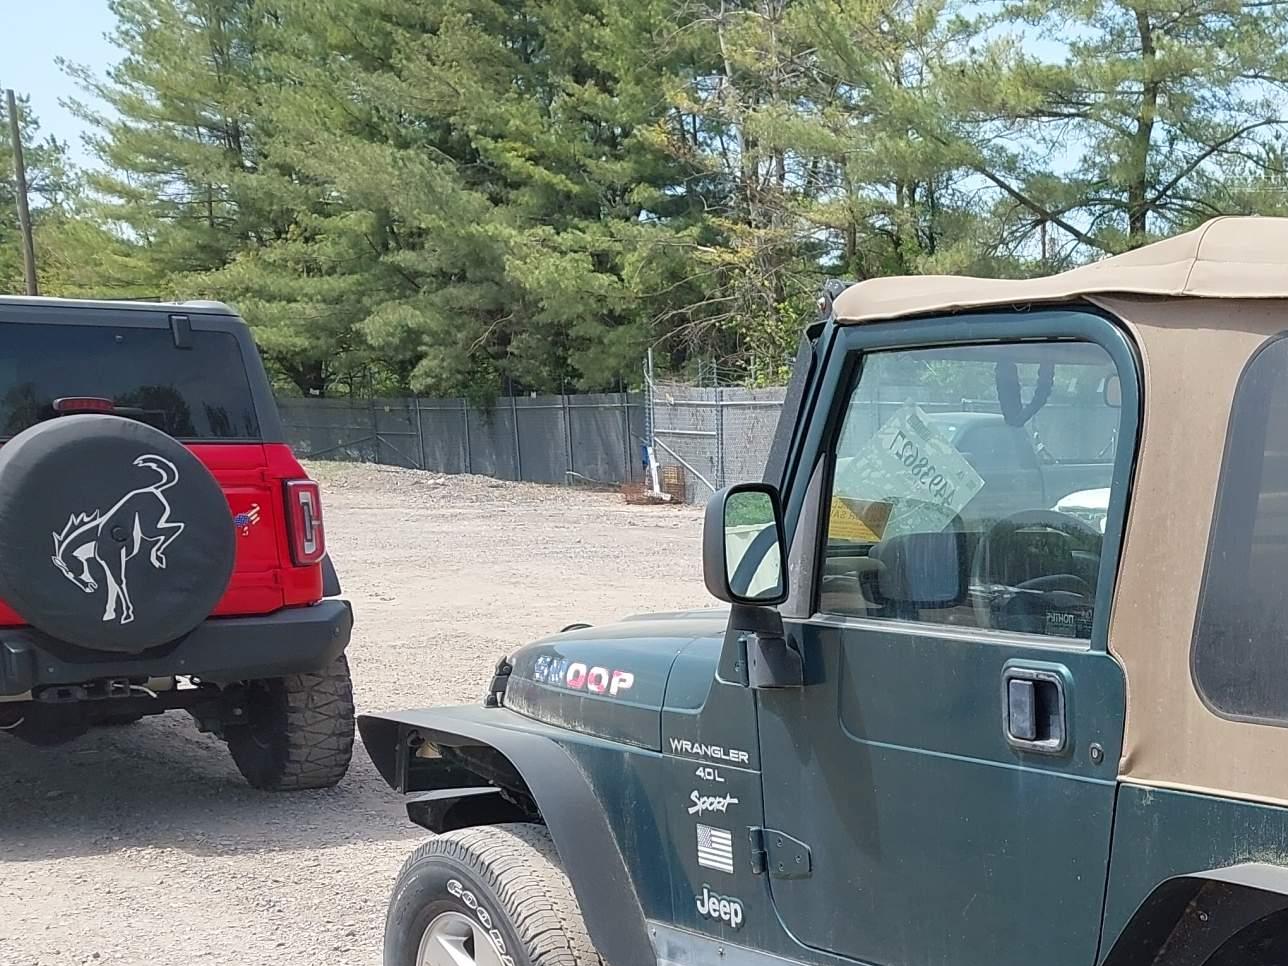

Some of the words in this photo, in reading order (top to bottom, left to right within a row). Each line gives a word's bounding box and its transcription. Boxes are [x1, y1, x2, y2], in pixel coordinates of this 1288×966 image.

[669, 737, 749, 764] WRANGLER
[687, 790, 739, 817] Sport
[696, 885, 744, 929] Jeep
